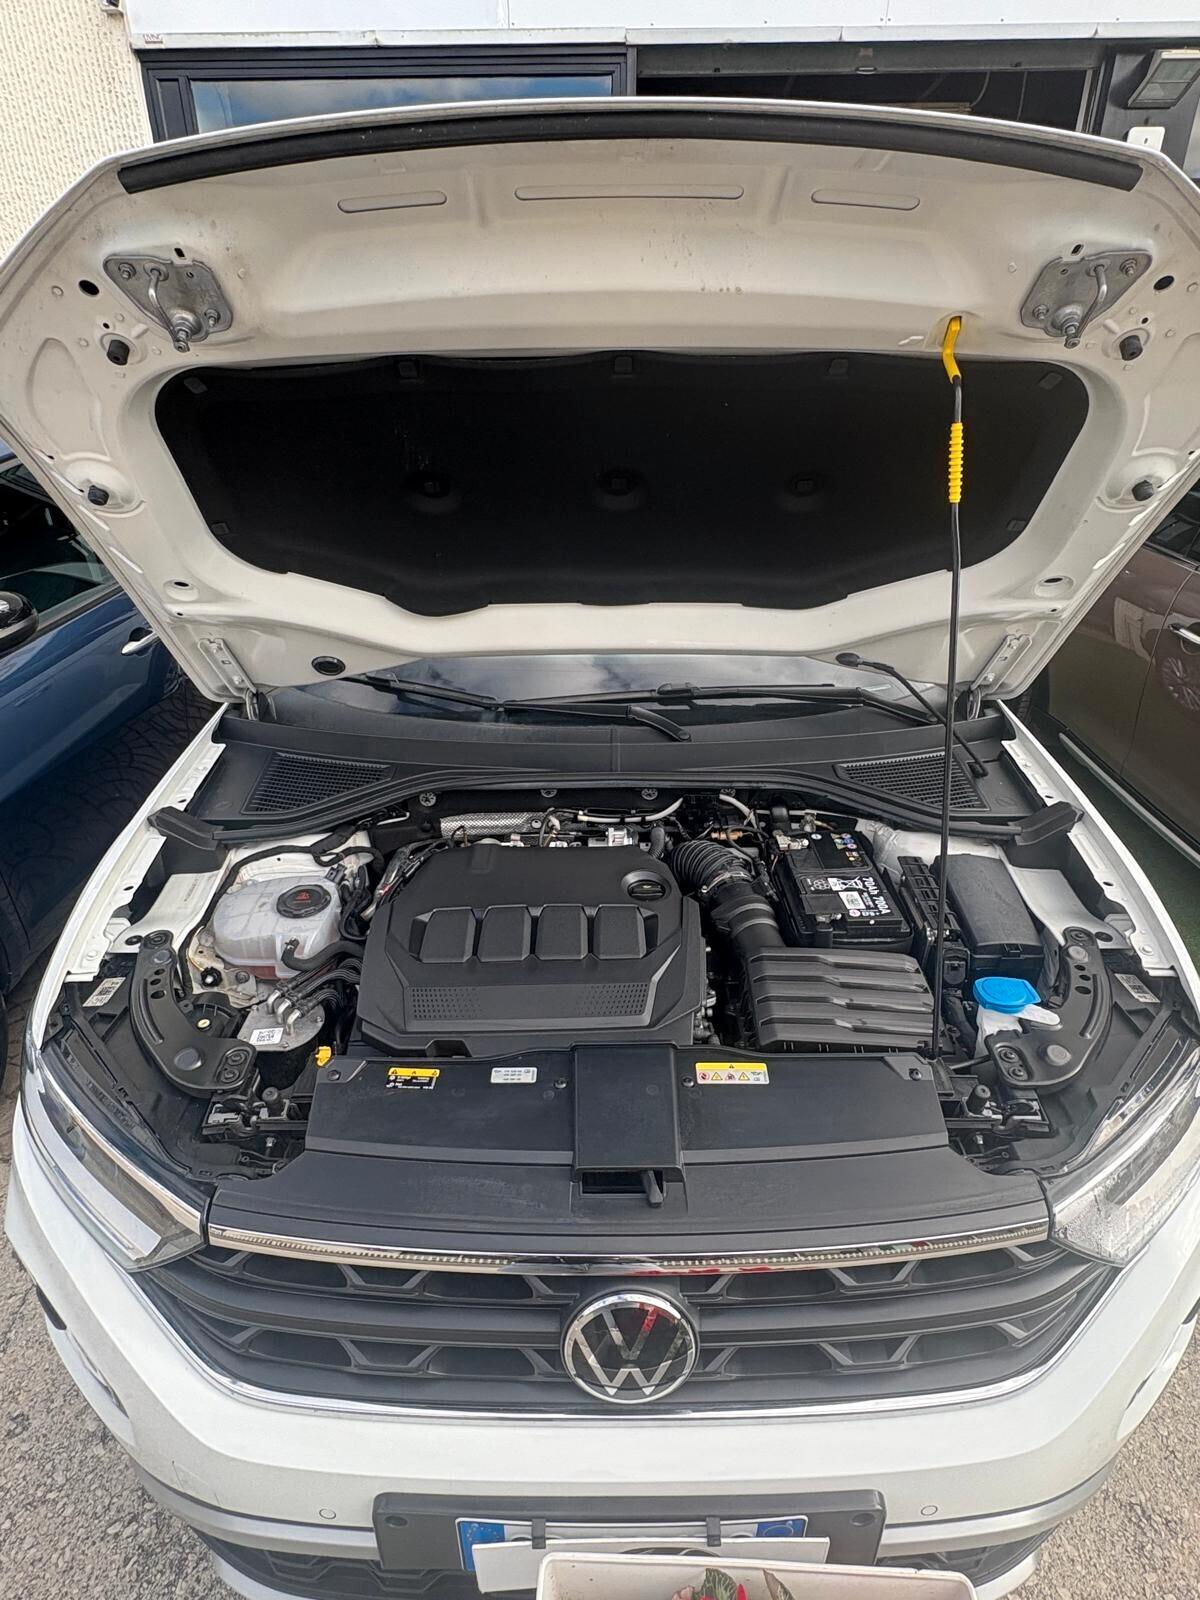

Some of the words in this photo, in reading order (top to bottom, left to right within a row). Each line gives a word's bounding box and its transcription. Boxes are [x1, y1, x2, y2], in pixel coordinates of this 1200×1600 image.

[862, 877, 880, 895] 70Ah
[872, 896, 892, 914] 700A
[568, 1299, 692, 1399] VW
